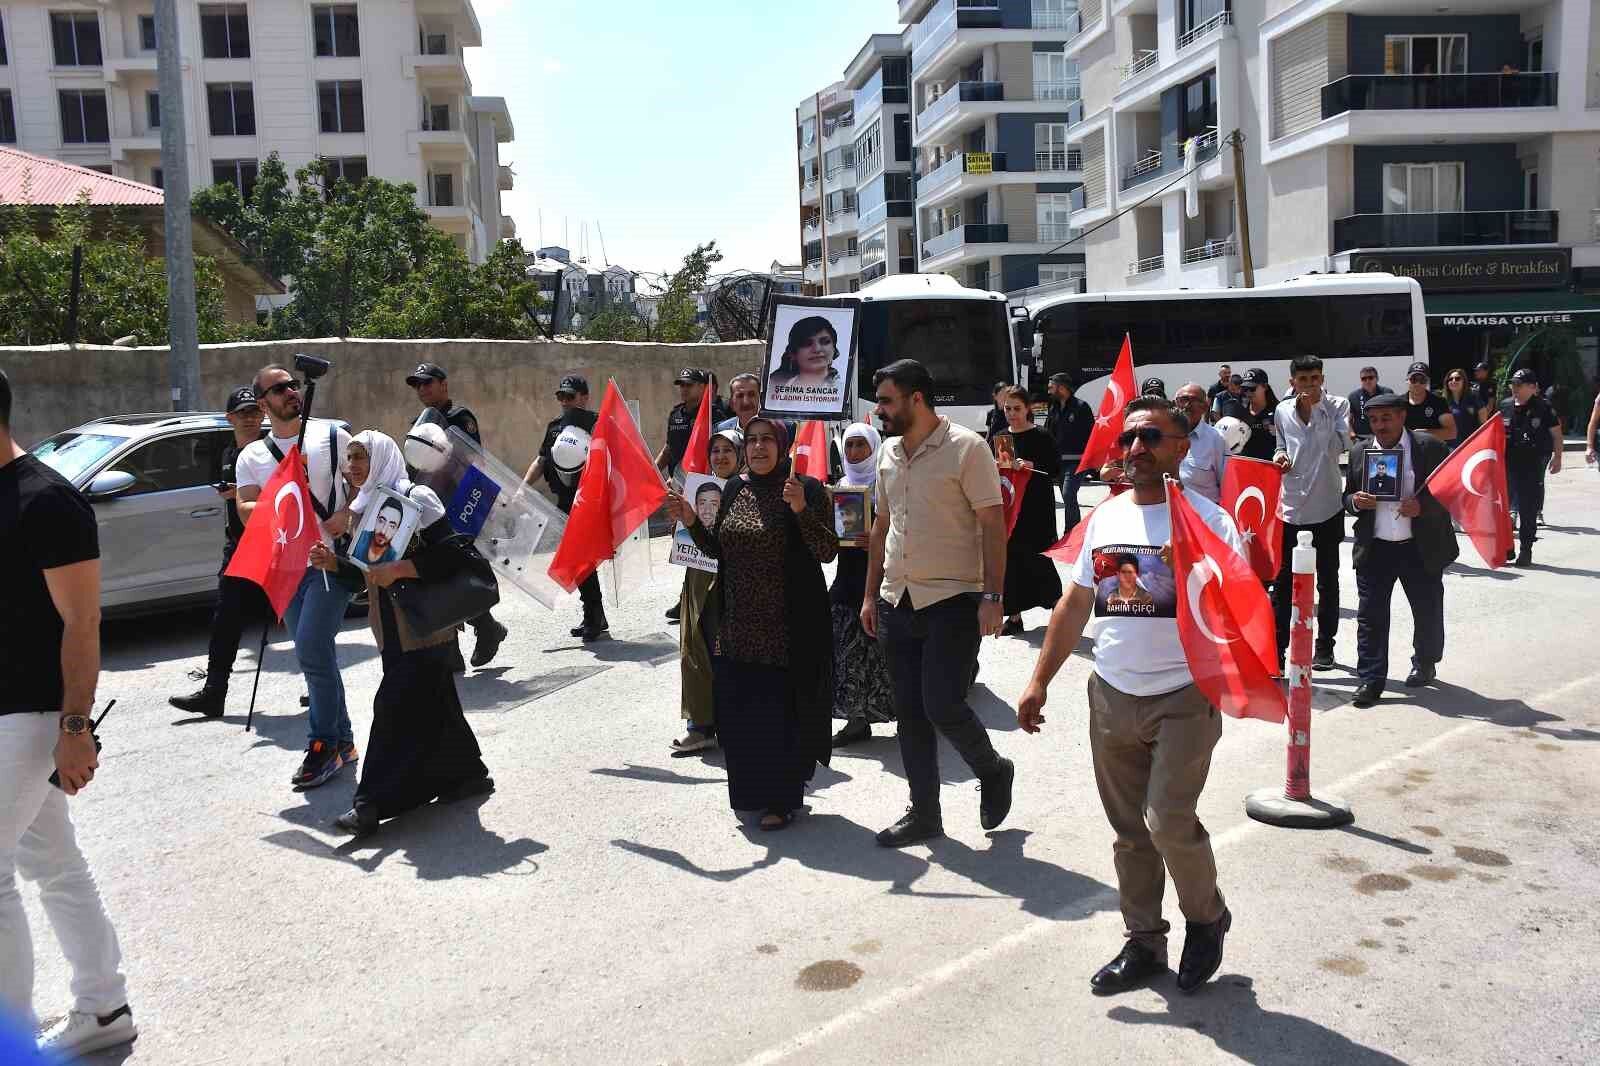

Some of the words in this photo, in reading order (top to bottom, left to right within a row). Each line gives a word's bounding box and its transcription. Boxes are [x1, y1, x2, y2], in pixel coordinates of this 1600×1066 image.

[1442, 262, 1483, 276] Coffee
[1486, 262, 1497, 275] &
[1501, 260, 1560, 275] Breakfast
[1512, 314, 1572, 324] COFFEE
[806, 386, 839, 395] SANCAR
